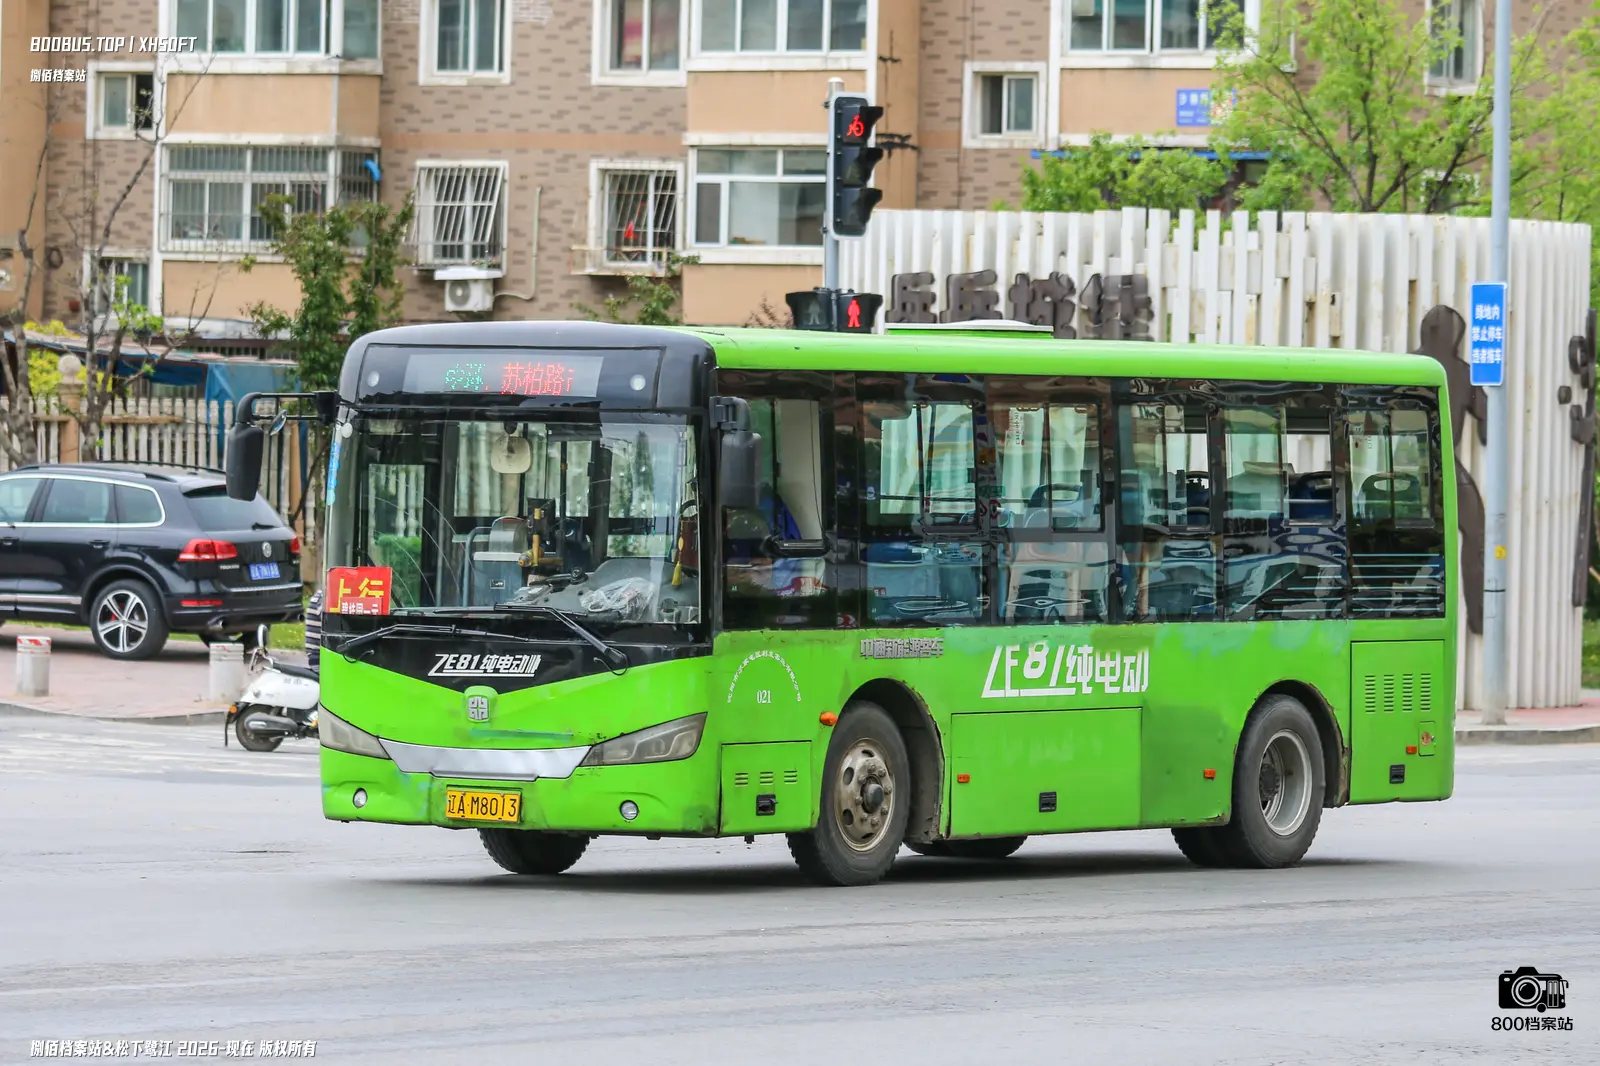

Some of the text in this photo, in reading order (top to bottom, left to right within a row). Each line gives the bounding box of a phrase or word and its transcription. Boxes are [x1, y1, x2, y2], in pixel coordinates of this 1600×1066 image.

[1475, 304, 1501, 320] 绿地内
[1472, 325, 1502, 342] 禁止停车
[329, 578, 385, 613] 上行
[860, 637, 944, 659] 中通新能源客车
[756, 689, 772, 704] 021
